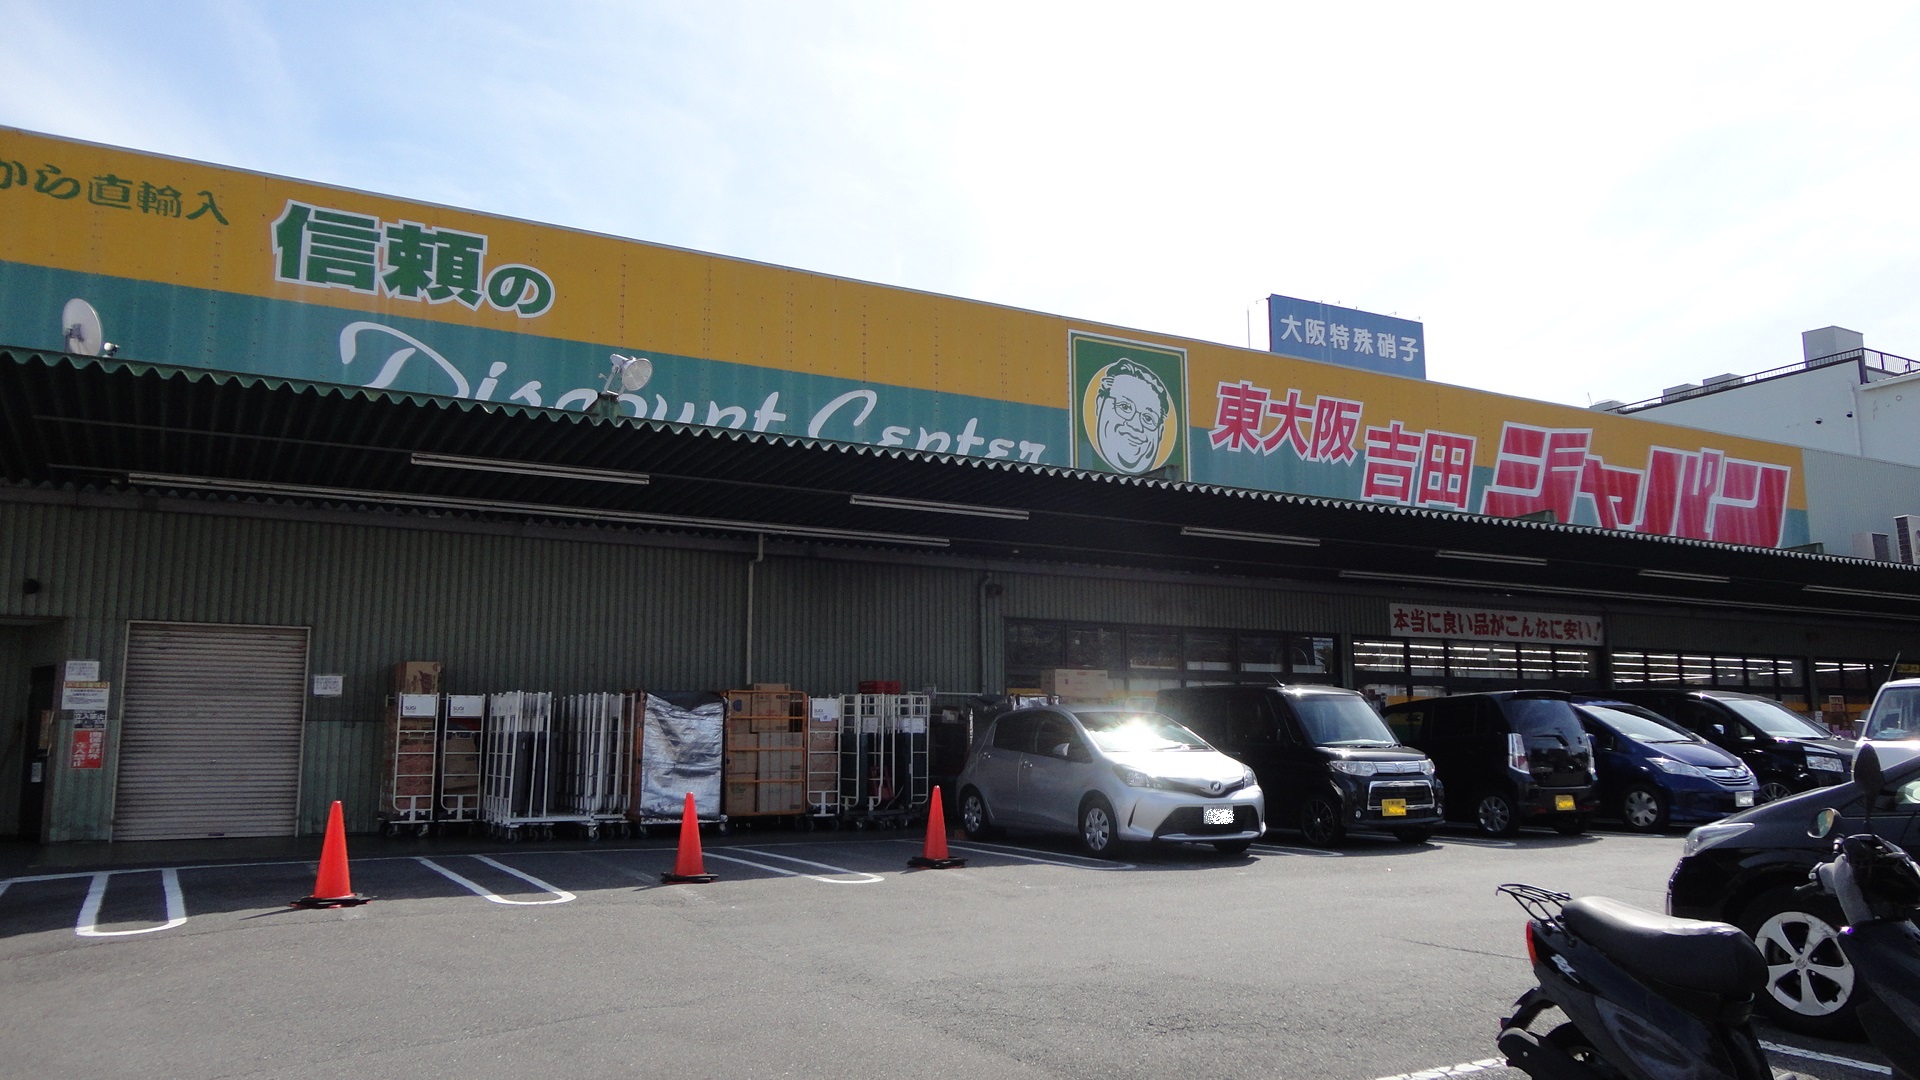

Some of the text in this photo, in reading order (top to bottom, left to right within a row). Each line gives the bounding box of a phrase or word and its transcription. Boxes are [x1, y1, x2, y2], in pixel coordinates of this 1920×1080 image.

[270, 199, 556, 318] 信頼の
[1280, 315, 1419, 362] 大阪特殊硝子
[1208, 380, 1791, 549] 東大阪 吉田 ジャパン
